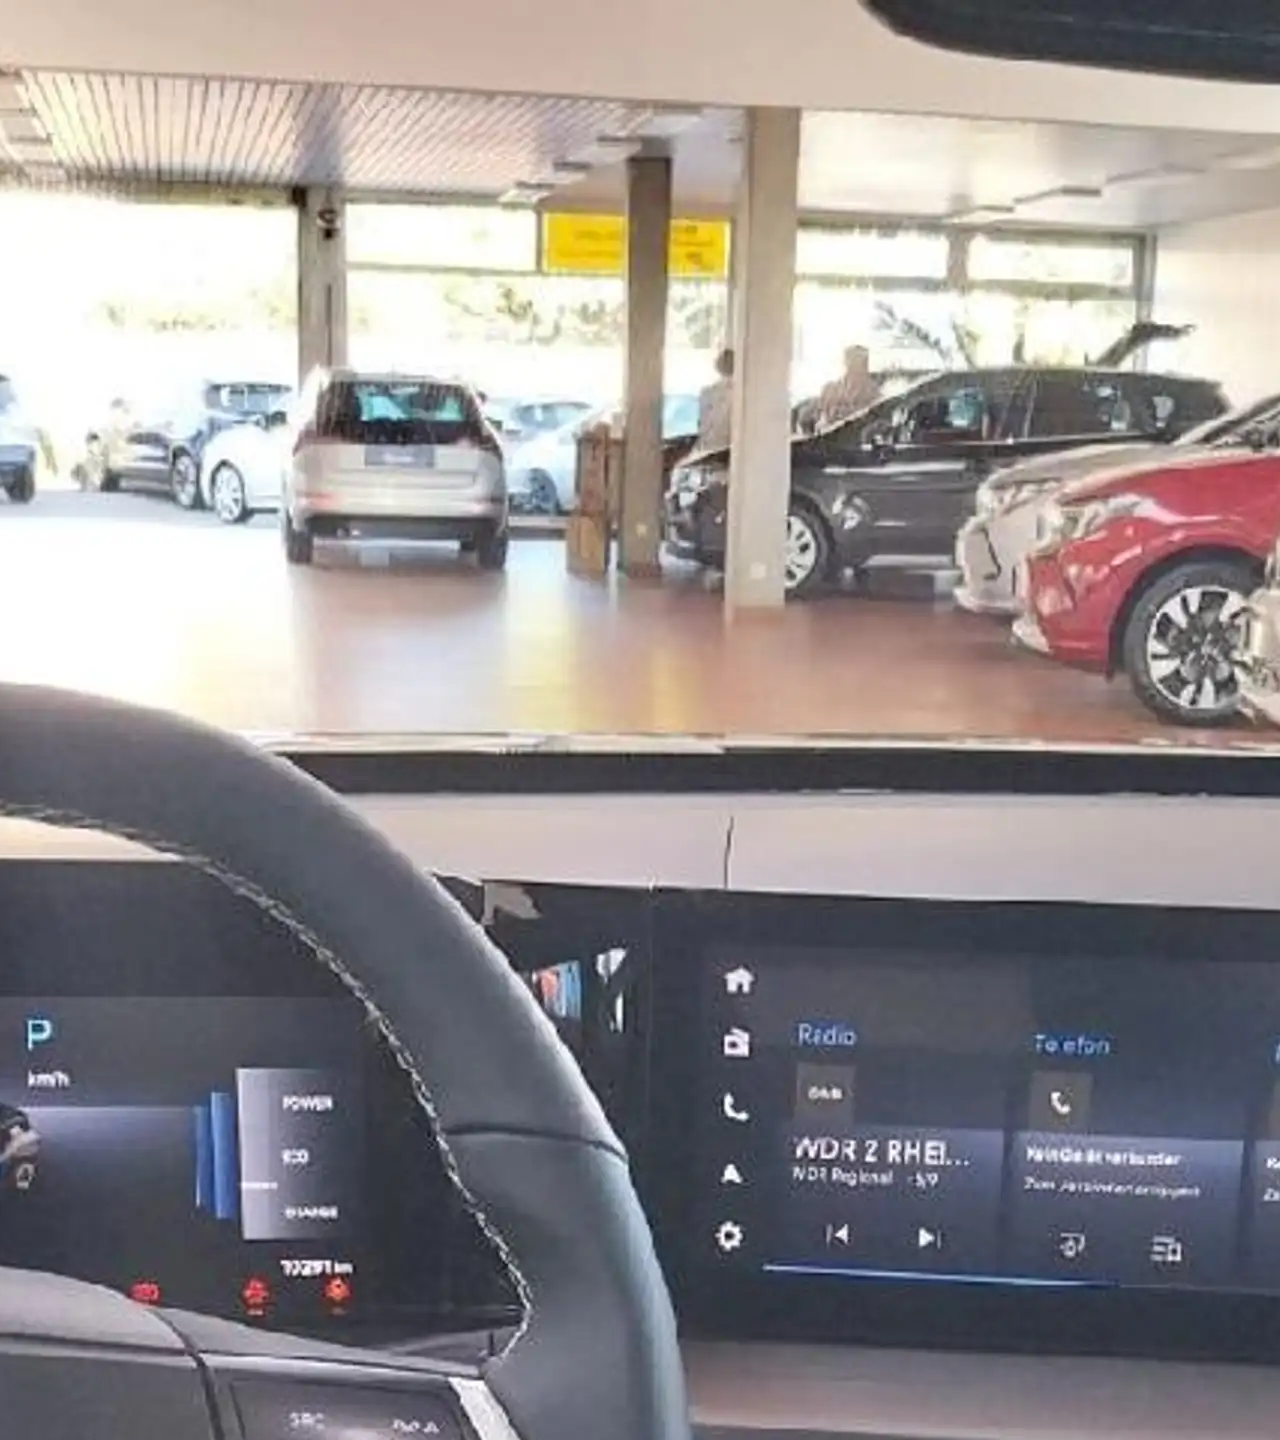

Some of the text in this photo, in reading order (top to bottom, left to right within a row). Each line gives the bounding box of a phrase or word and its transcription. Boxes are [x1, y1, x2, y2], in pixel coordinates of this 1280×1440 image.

[27, 1019, 53, 1050] P
[798, 1022, 858, 1046] Radio
[27, 1069, 69, 1088] km/h
[794, 1138, 857, 1162] WDR
[864, 1140, 879, 1163] 2
